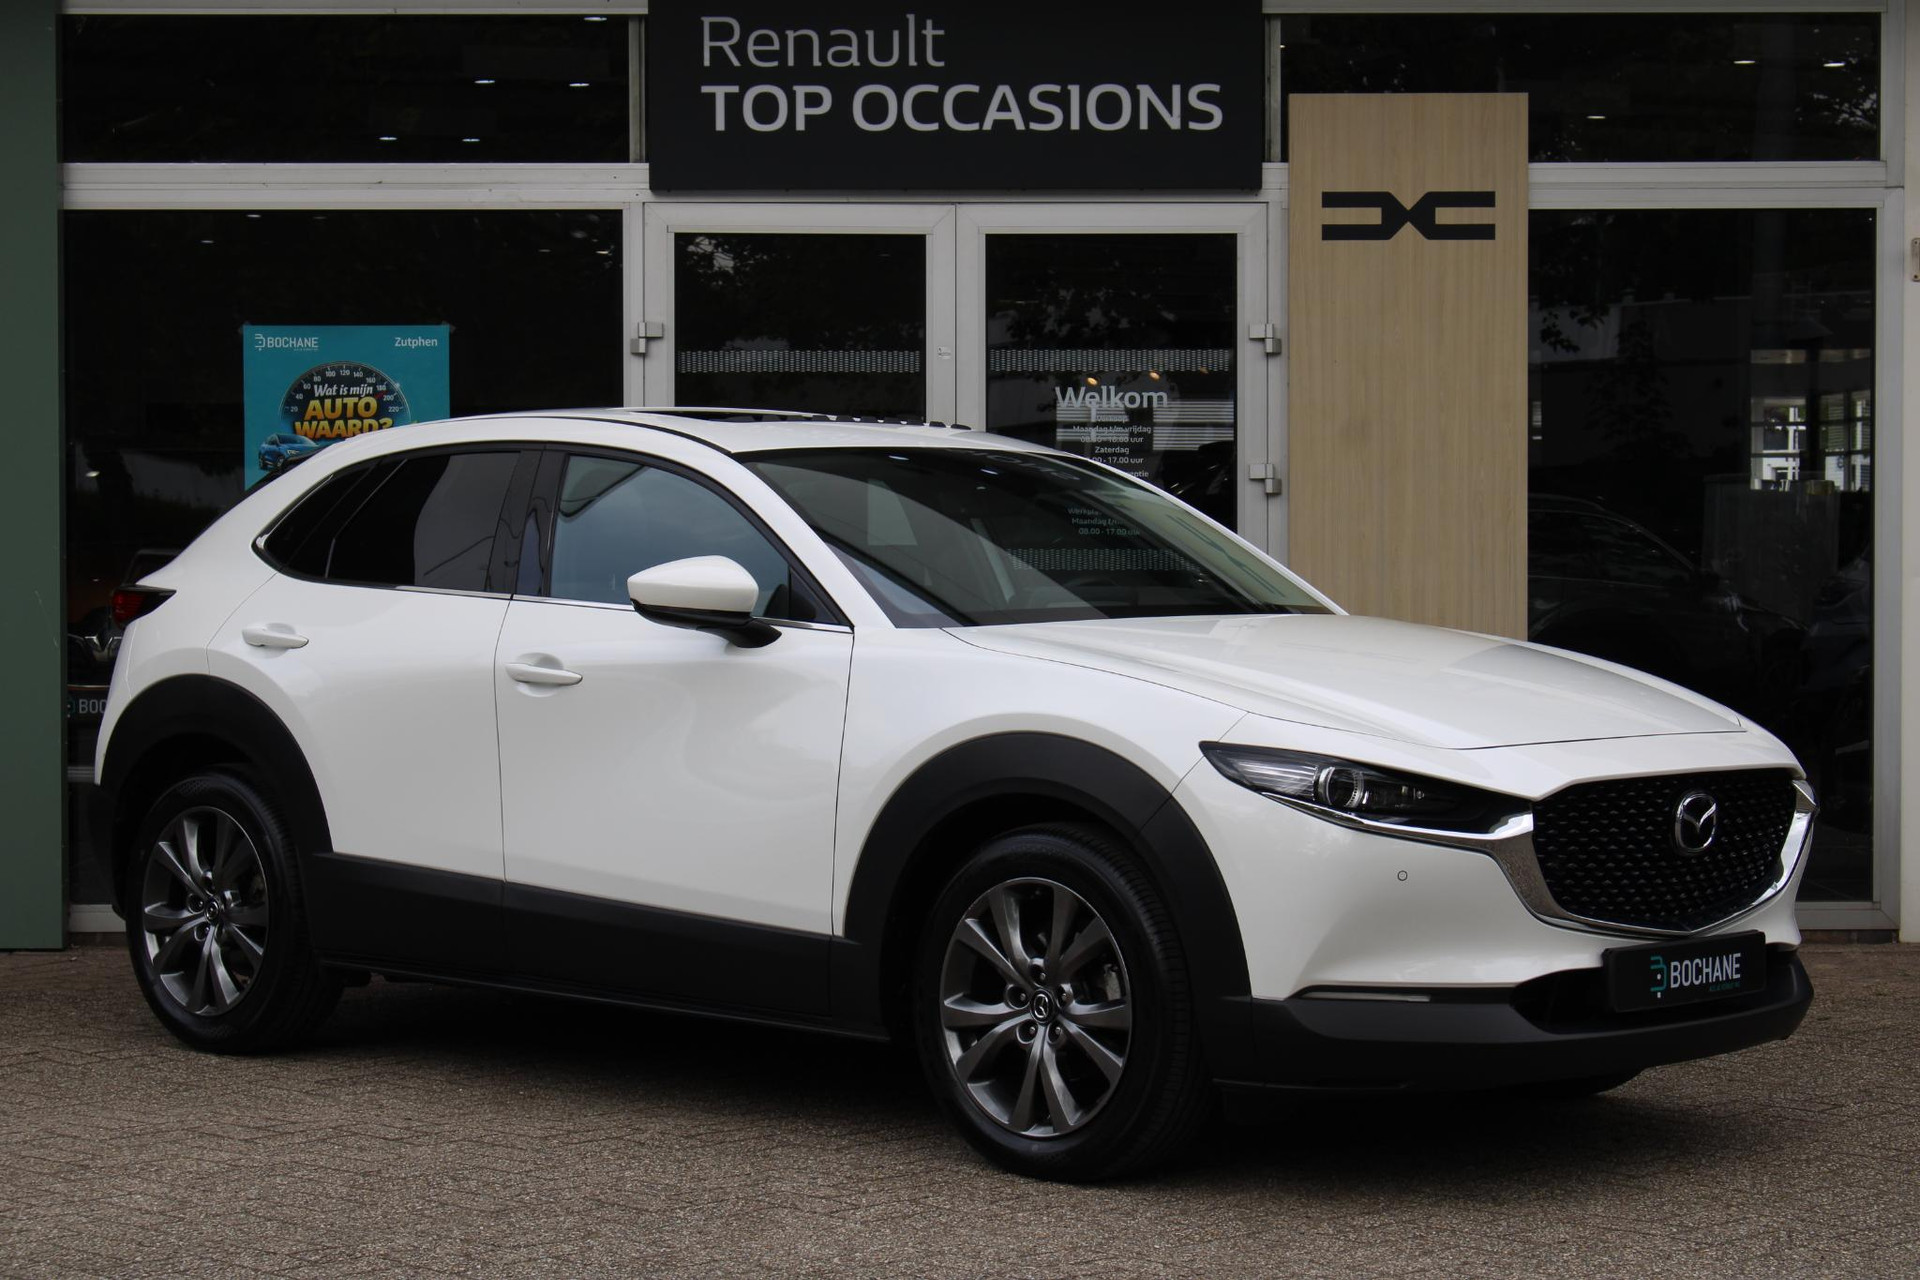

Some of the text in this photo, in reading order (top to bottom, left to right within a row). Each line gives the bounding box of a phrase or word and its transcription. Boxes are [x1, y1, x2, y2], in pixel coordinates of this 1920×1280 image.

[701, 14, 945, 68] Renault
[701, 82, 1224, 132] TOP OCCASIONS
[267, 337, 319, 348] BOCHANE
[395, 336, 438, 349] Zutphen
[290, 405, 299, 413] 20
[325, 370, 336, 378] 100
[388, 405, 400, 413] 220
[314, 384, 373, 398] Wat is mijn
[1055, 385, 1168, 409] Welkom
[304, 396, 378, 420] AUTO
[1072, 425, 1108, 435] Maandag
[1124, 425, 1151, 434] vrijdag
[1095, 446, 1130, 455] Zaterdag
[1071, 517, 1107, 526] Maandag
[1078, 527, 1101, 535] 08.00
[1106, 528, 1127, 536] 17.00
[1671, 953, 1741, 989] BOCHANE
